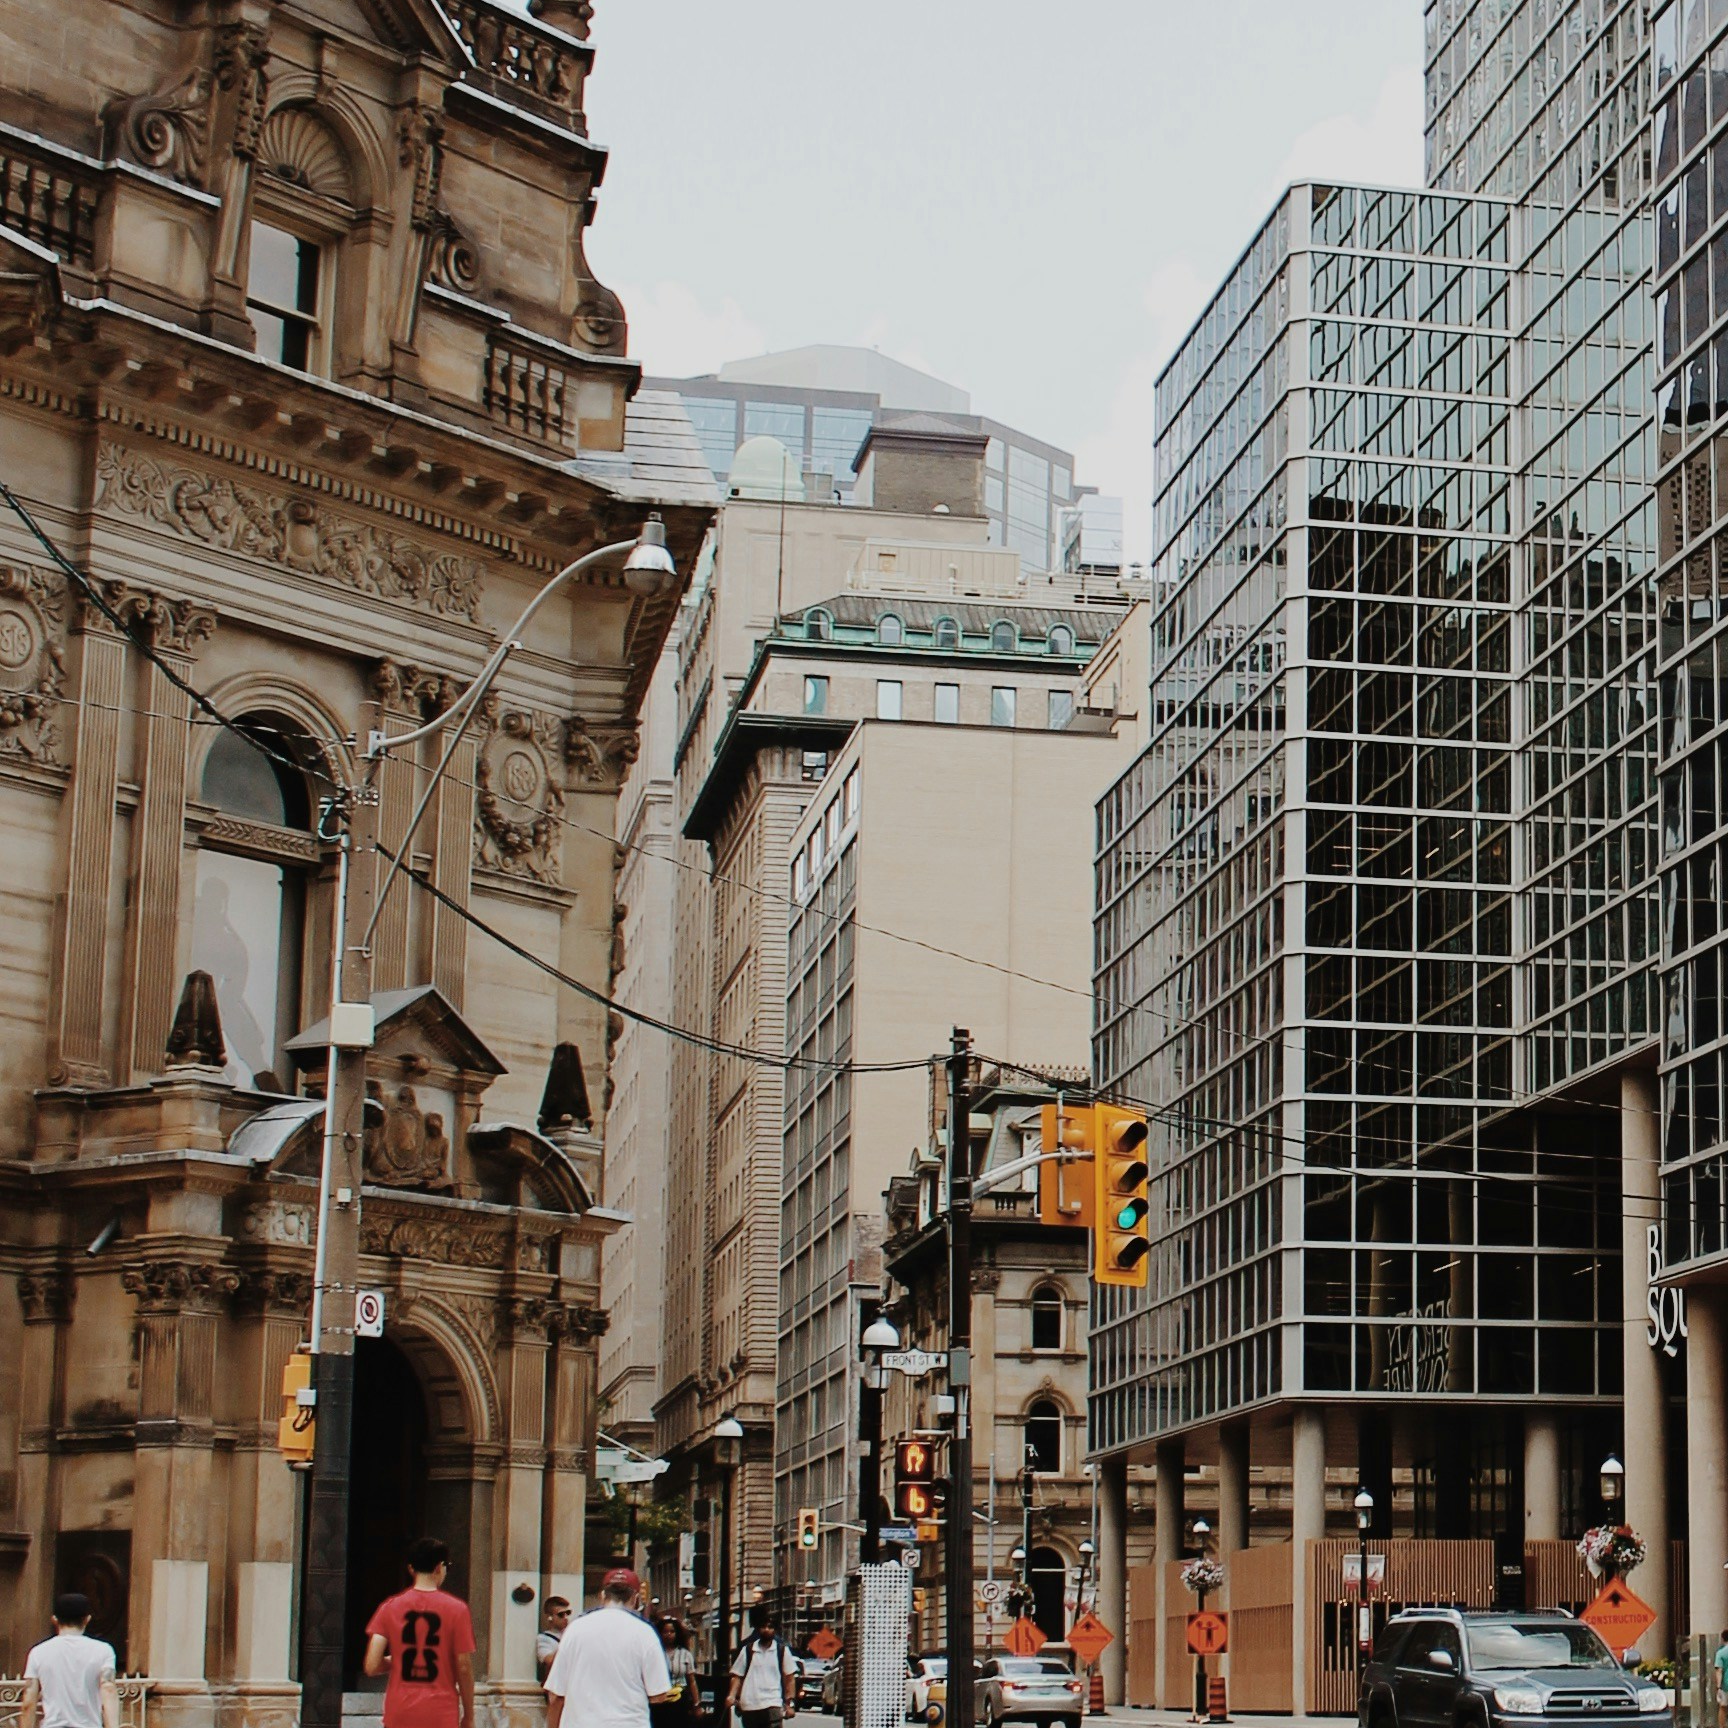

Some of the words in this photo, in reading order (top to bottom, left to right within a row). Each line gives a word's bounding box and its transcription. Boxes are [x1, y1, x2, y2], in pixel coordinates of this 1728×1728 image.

[886, 1355, 916, 1366] FRONT
[919, 1355, 930, 1365] ST
[1585, 1614, 1649, 1625] CONSTRUCTION
